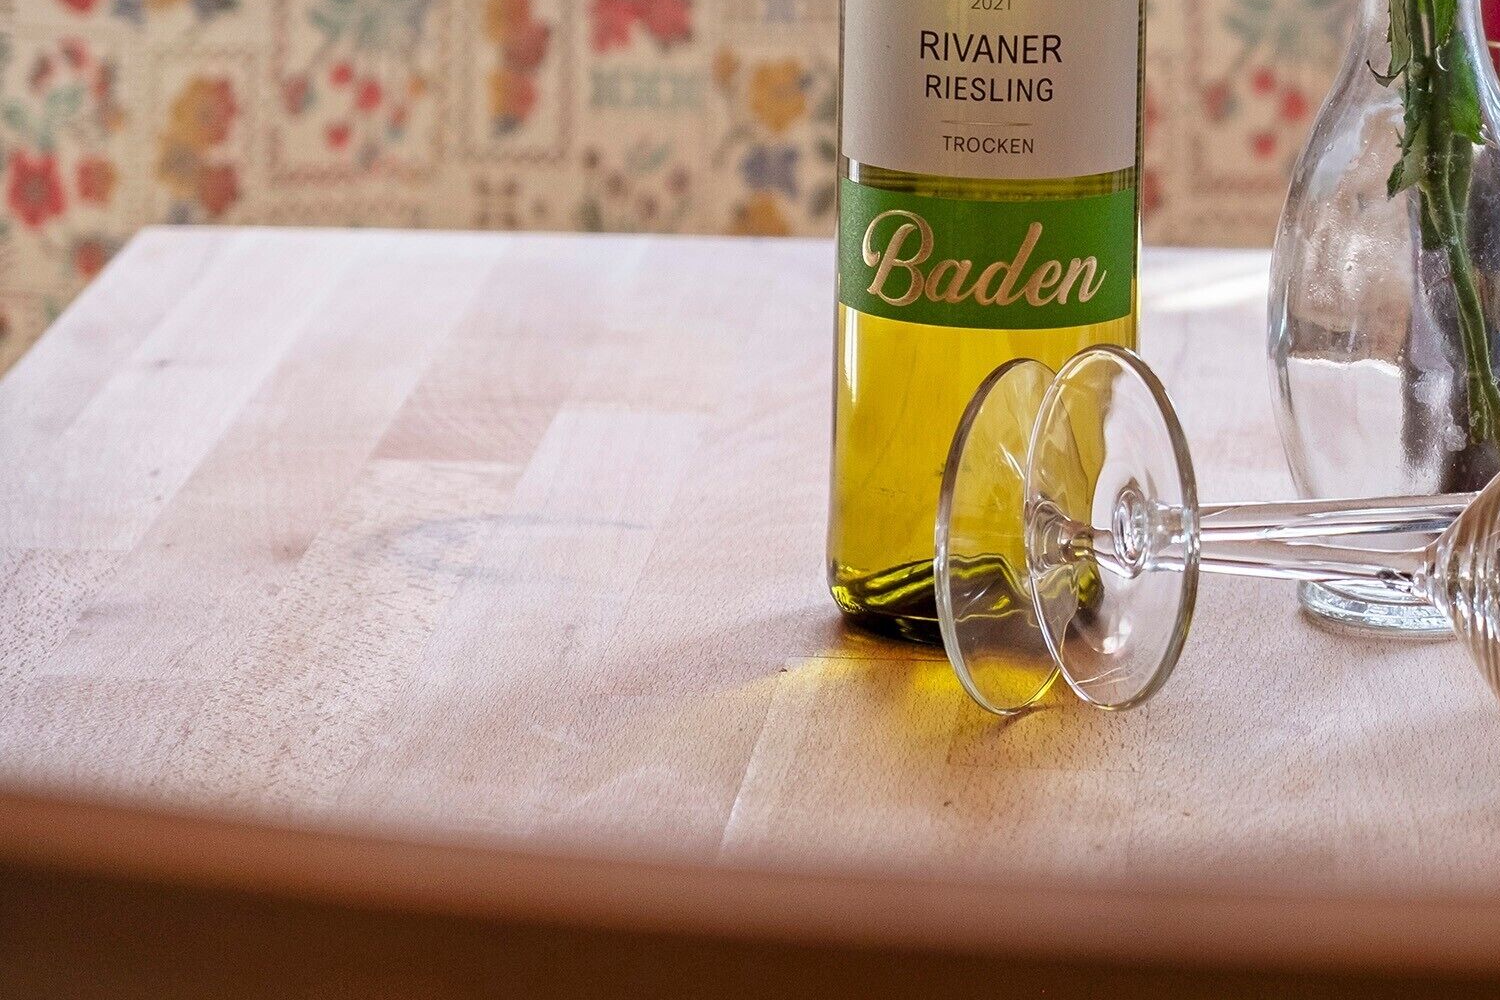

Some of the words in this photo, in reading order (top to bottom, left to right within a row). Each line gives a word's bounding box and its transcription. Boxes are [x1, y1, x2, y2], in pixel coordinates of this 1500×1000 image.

[919, 30, 1063, 64] RIVANER
[924, 74, 1054, 102] RIESLING
[942, 135, 1034, 154] TROCKEN
[861, 209, 1107, 307] Baden
